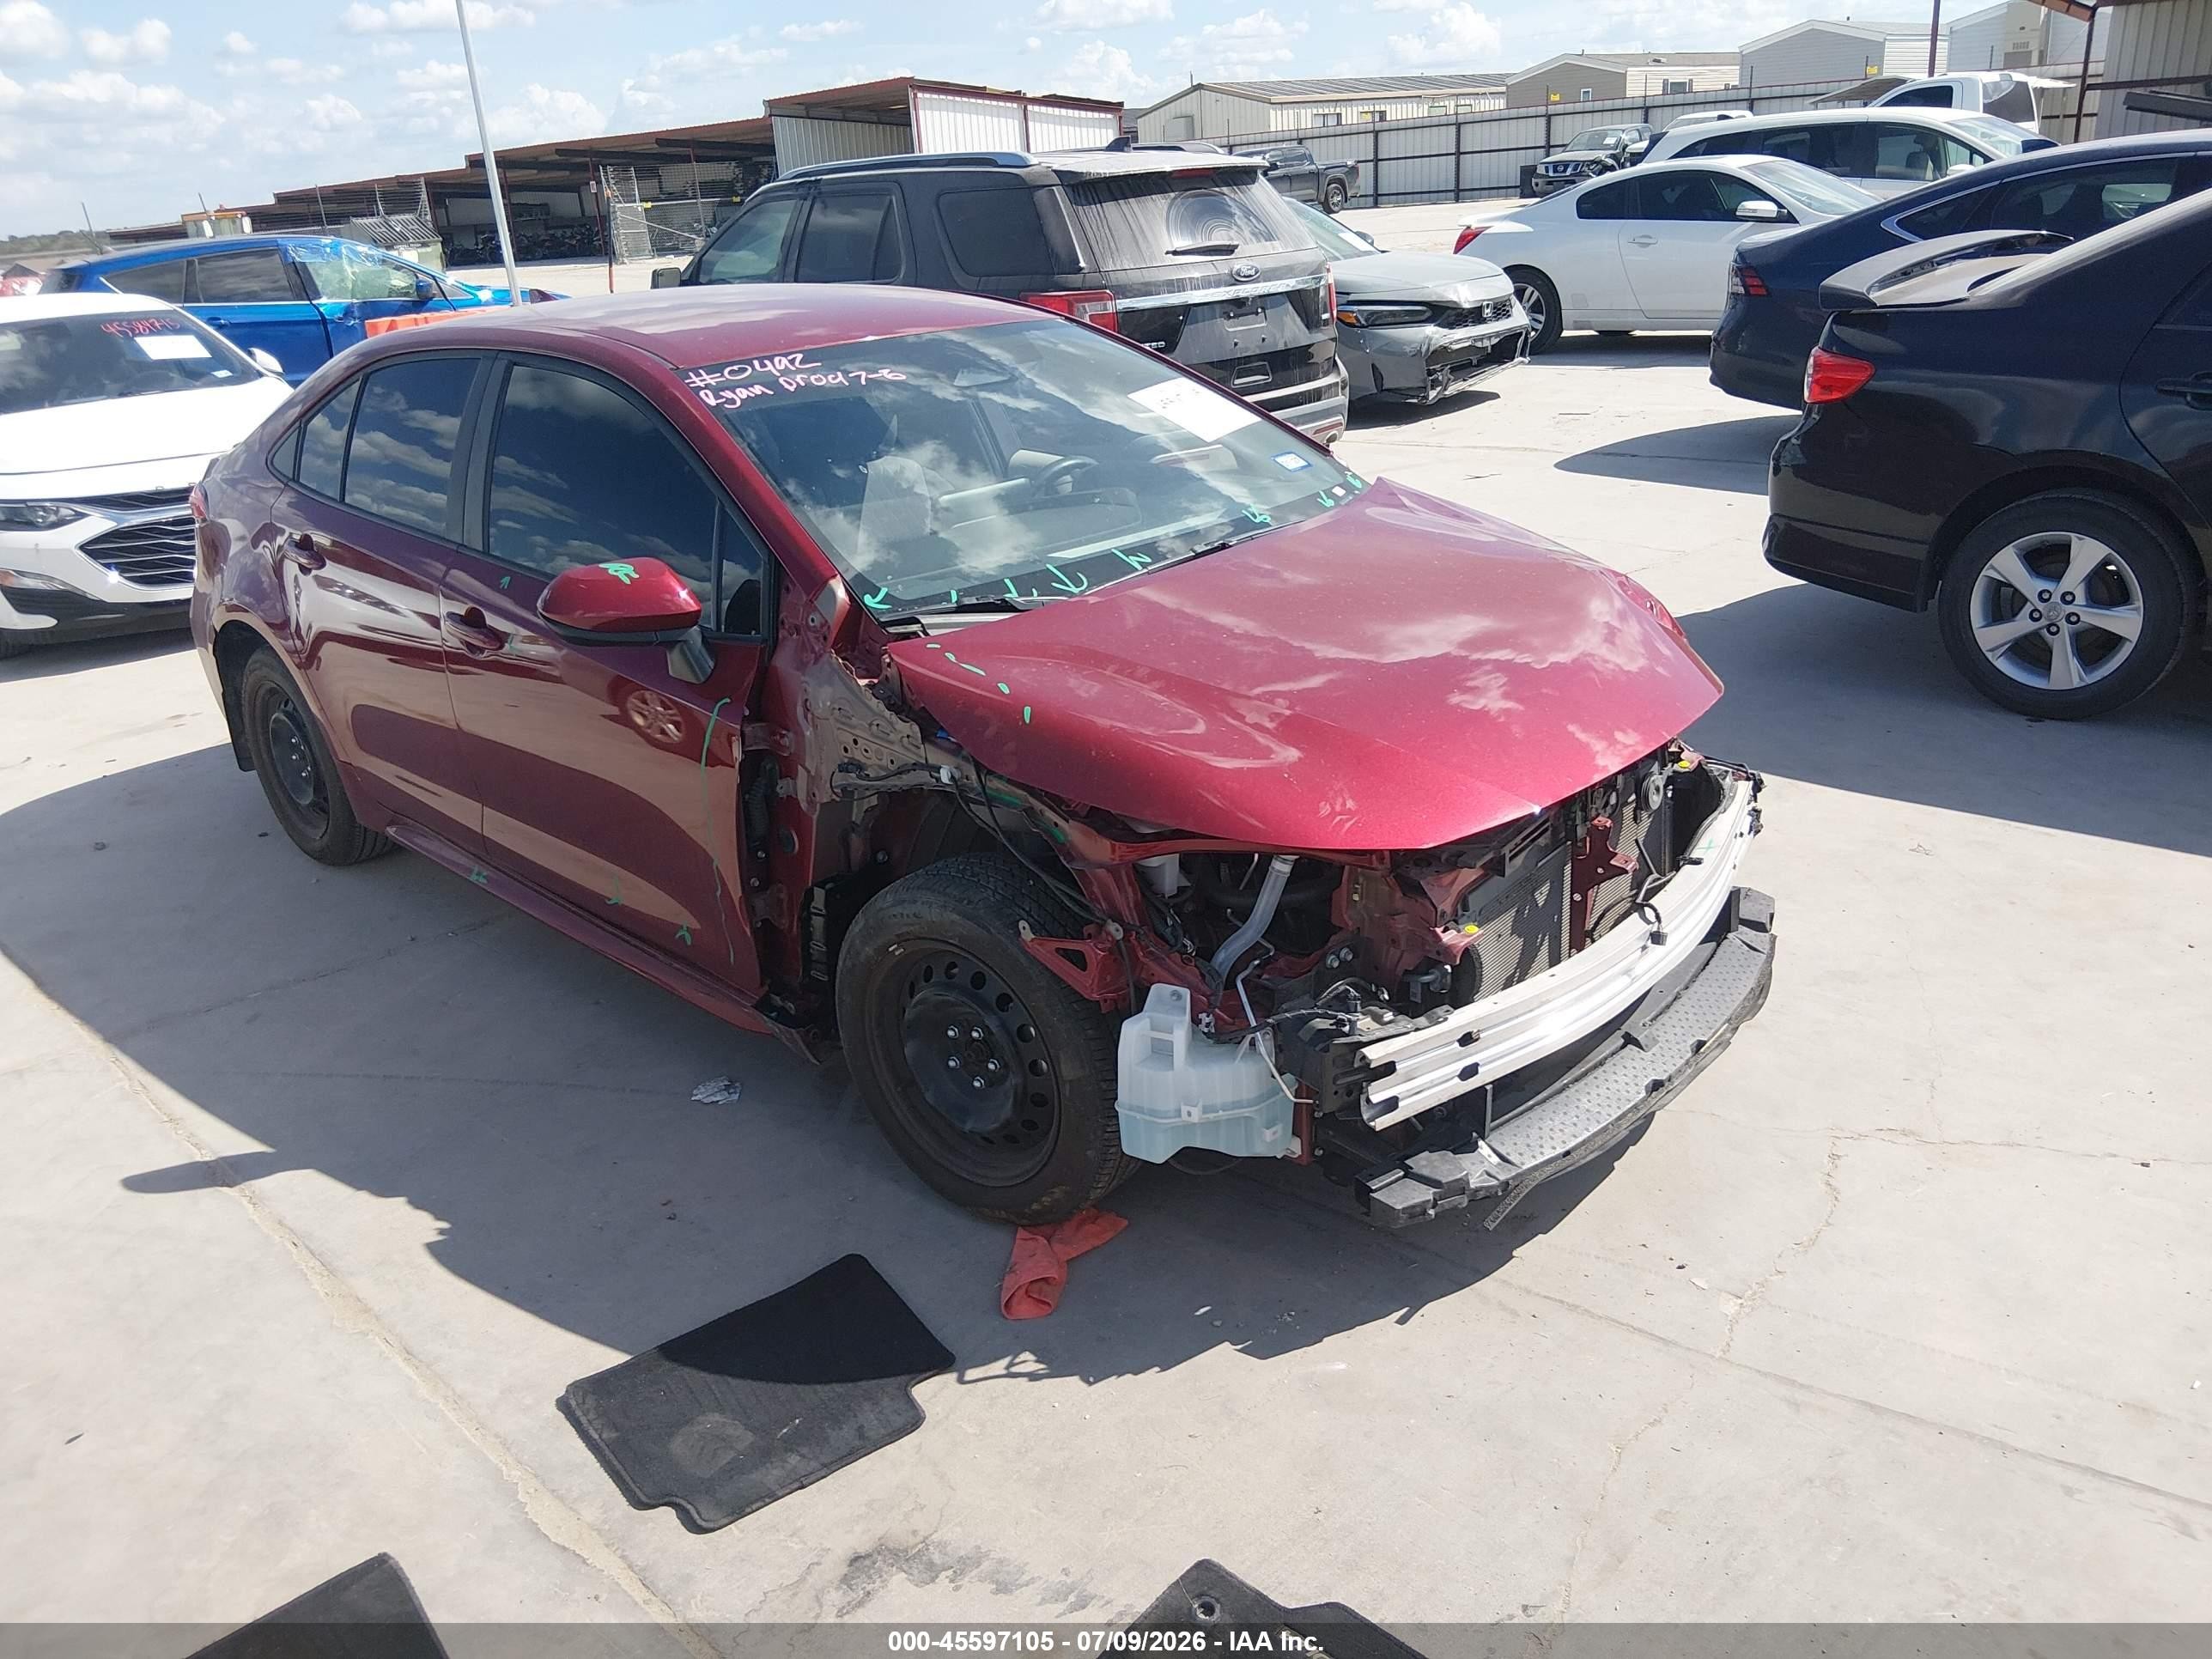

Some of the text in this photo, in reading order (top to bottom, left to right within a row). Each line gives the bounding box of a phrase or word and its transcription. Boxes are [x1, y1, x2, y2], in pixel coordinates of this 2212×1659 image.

[1239, 265, 1256, 277] Ford
[684, 353, 823, 389] #0492
[699, 384, 775, 410] Ryan
